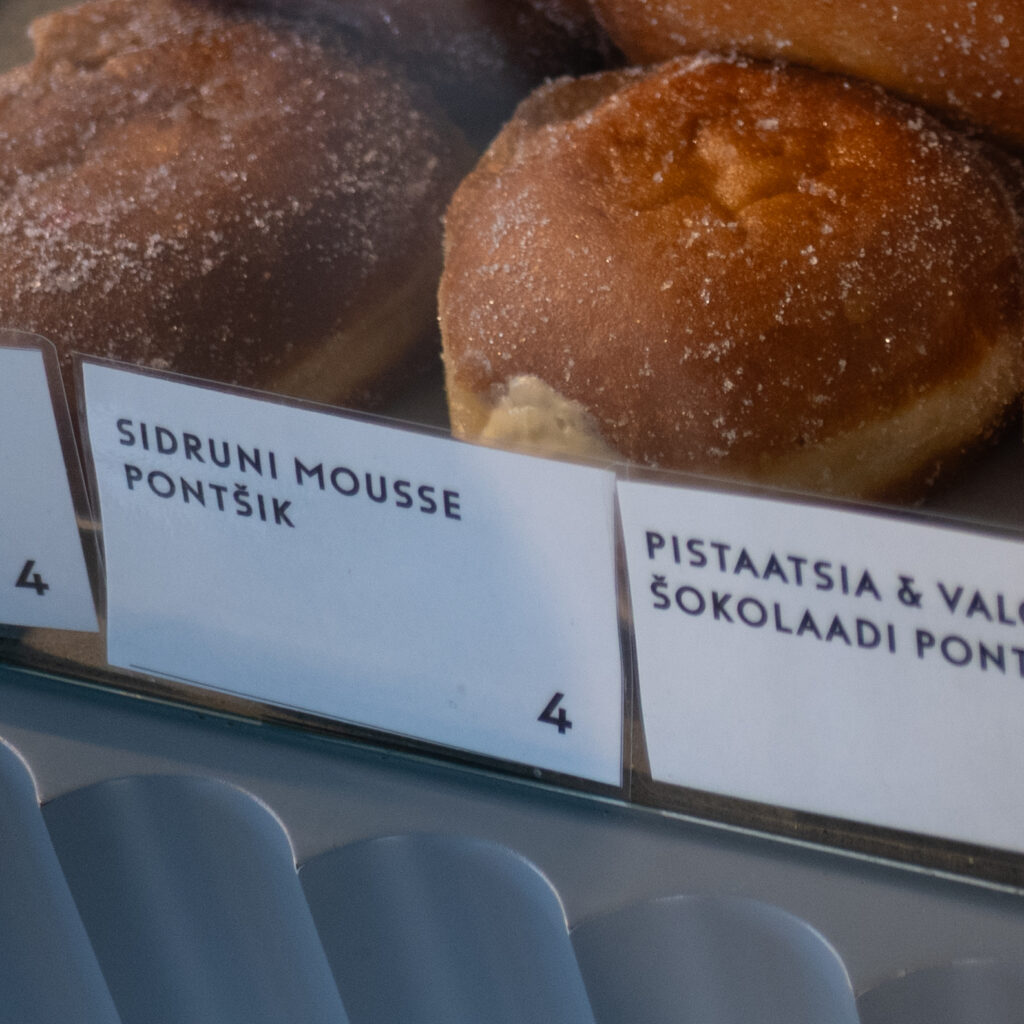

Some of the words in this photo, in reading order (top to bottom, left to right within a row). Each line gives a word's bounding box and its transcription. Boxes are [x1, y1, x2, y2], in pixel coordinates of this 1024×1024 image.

[116, 418, 278, 480] SIDRUNI
[294, 456, 462, 521] MOUSSE
[123, 463, 296, 529] PONTŠIK
[14, 559, 50, 597] 4
[645, 530, 882, 602] PISTAATSIA
[896, 574, 923, 609] &
[650, 574, 896, 654] ŠOKOLAADI
[536, 691, 573, 735] 4
